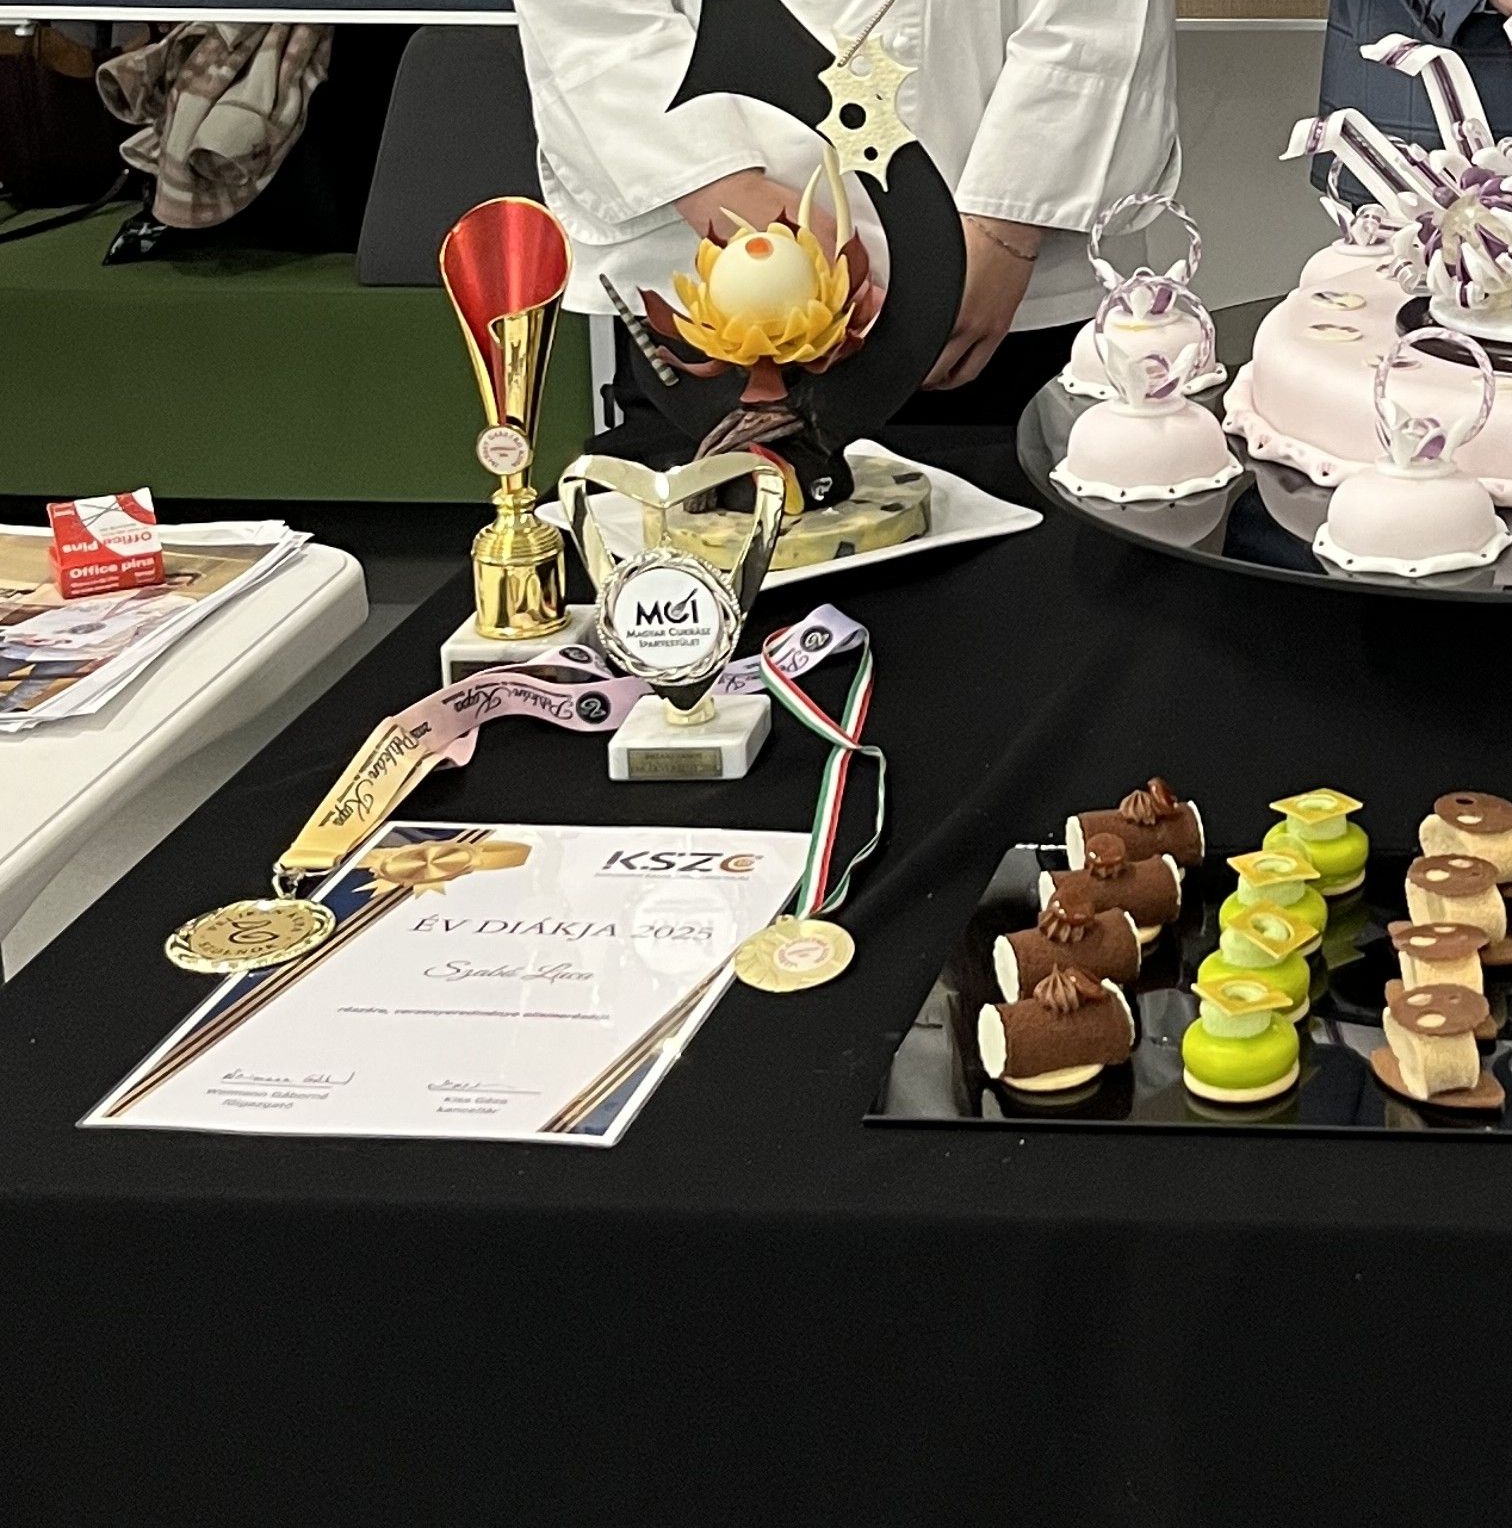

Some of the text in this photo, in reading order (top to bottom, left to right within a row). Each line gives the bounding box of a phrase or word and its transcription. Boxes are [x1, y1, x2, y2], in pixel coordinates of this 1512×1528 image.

[69, 564, 119, 579] Office
[121, 557, 155, 572] pins
[602, 850, 764, 873] KSZC
[409, 914, 714, 941] ÉV DIÁKJA 2025
[521, 963, 594, 984] Luca
